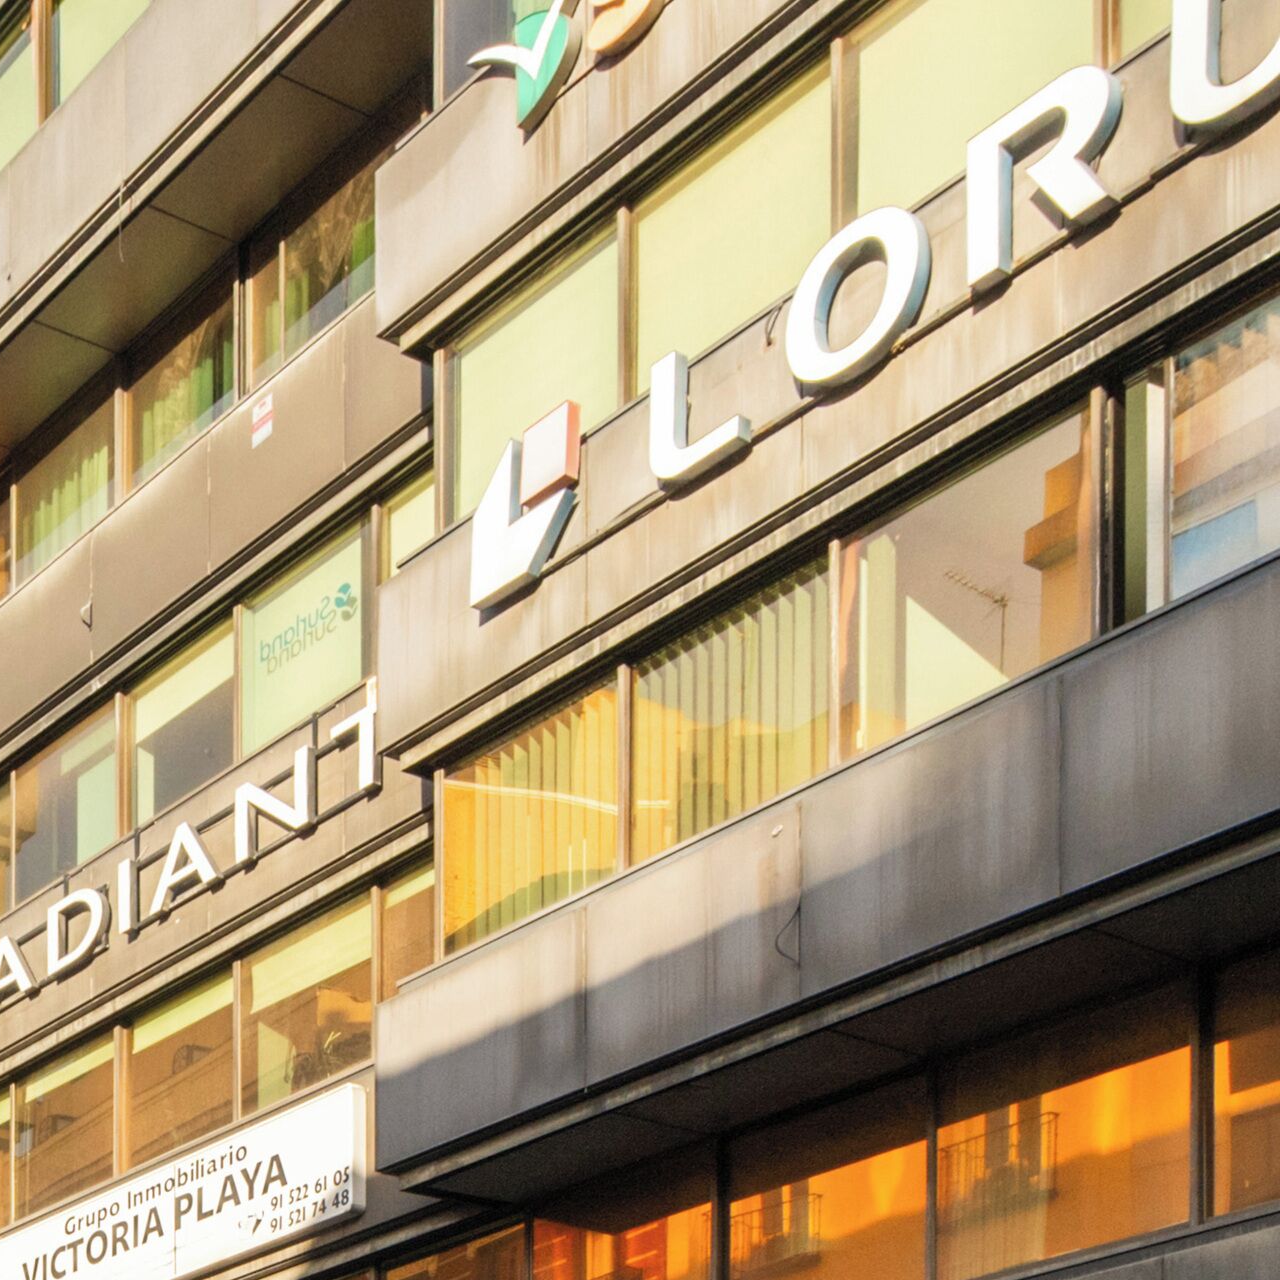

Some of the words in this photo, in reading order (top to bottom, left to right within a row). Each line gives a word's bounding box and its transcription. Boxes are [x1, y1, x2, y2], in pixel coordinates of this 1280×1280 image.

[64, 1199, 121, 1237] Grupo
[127, 1144, 248, 1208] Inmobiliario
[174, 1153, 288, 1232] PLAYA
[270, 1193, 283, 1212] 91
[288, 1183, 309, 1205] 522
[314, 1175, 328, 1195] 61
[333, 1165, 350, 1187] 05
[270, 1215, 283, 1234] 91
[288, 1206, 307, 1227] 521
[311, 1197, 328, 1218] 74
[332, 1188, 350, 1209] 48
